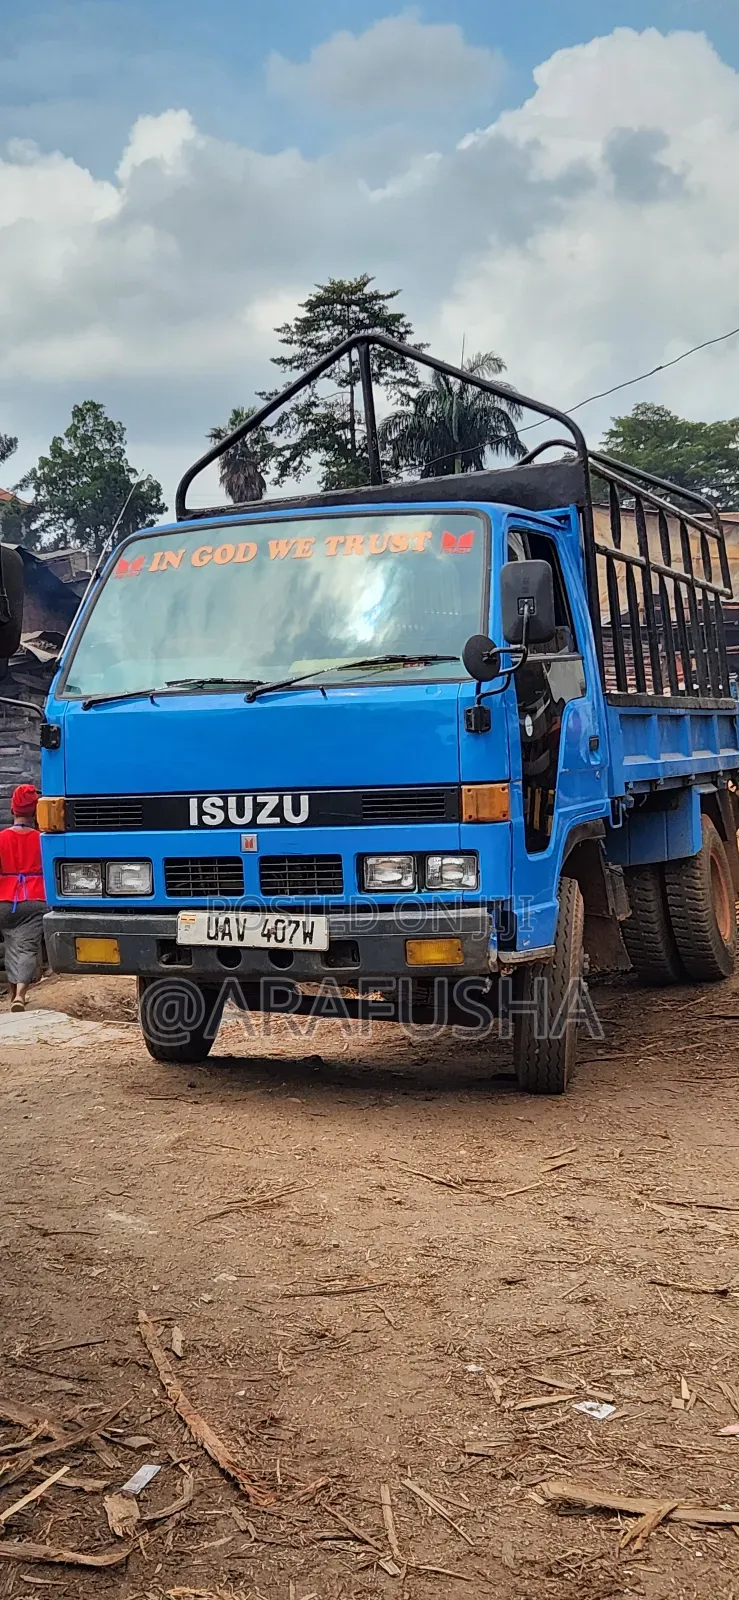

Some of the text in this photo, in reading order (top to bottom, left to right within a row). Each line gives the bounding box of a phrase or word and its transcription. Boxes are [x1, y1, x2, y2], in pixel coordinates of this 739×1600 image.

[148, 530, 432, 572] IN GOD WE TRUST
[189, 794, 310, 826] ISUZU
[206, 916, 315, 945] UAV 407W
